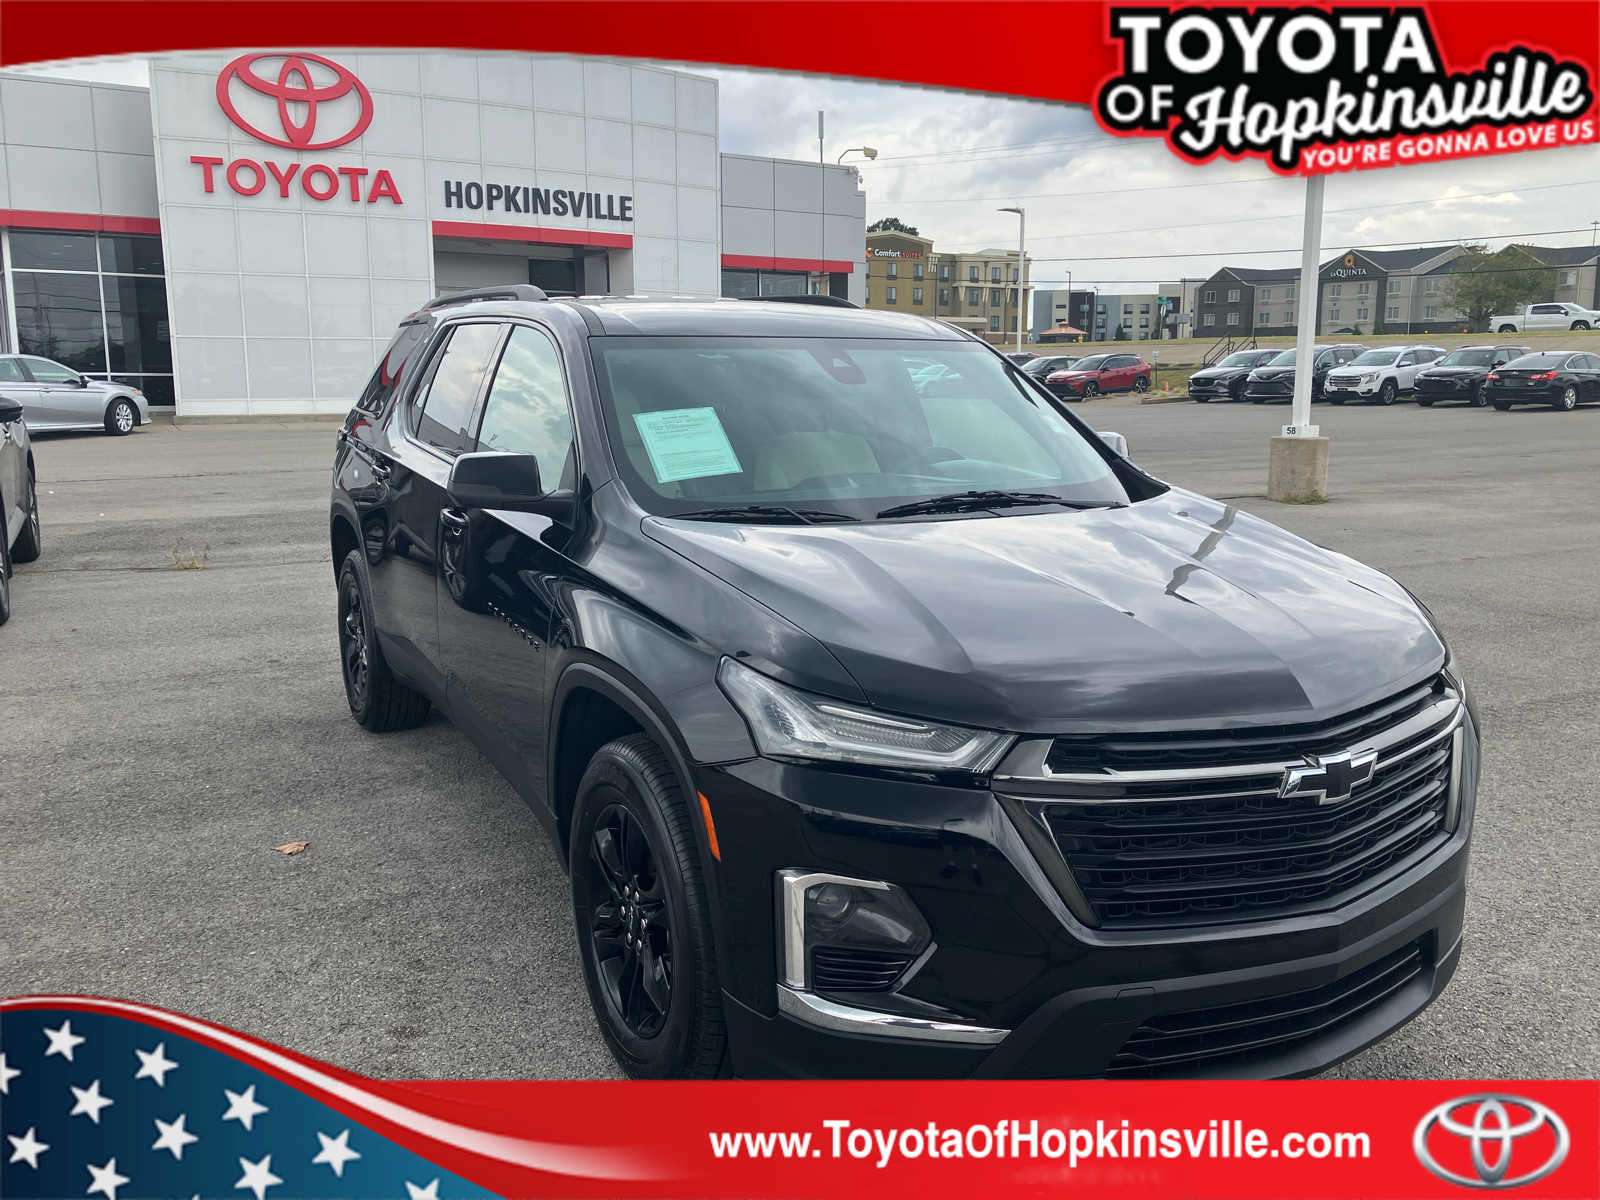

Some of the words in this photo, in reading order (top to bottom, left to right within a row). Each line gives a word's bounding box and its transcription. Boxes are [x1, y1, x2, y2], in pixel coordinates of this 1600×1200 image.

[190, 155, 403, 205] TOYOTA
[443, 180, 634, 222] HOPKINSVILLE
[874, 248, 900, 258] Comfort
[1286, 426, 1297, 435] 58
